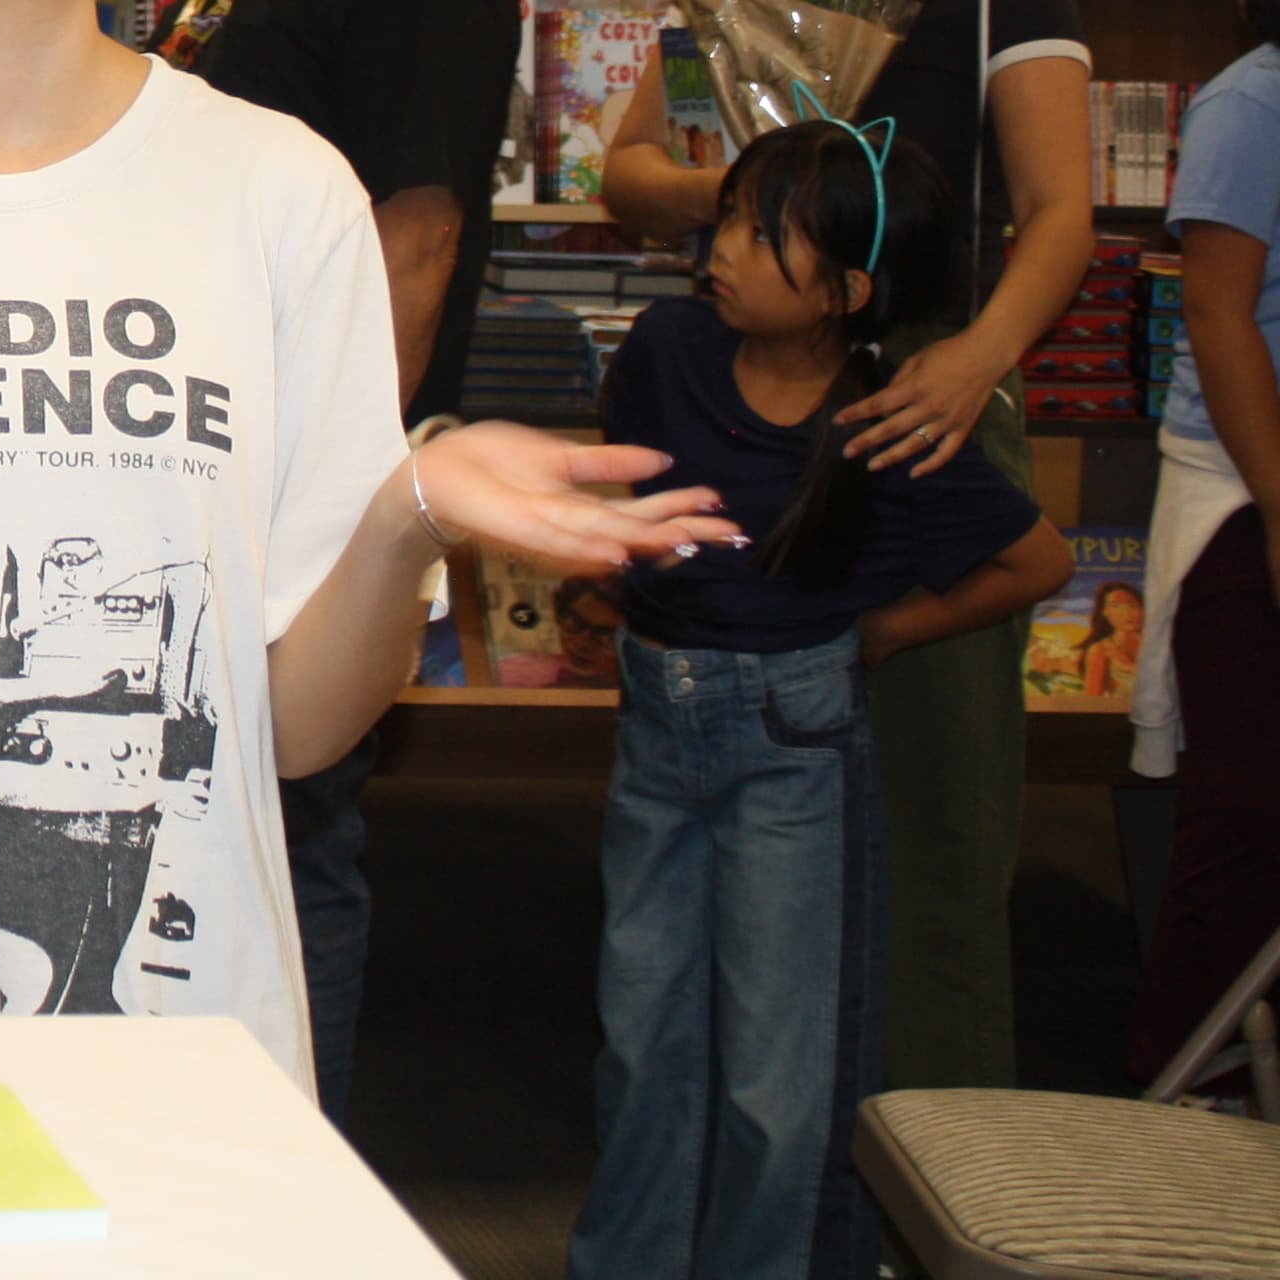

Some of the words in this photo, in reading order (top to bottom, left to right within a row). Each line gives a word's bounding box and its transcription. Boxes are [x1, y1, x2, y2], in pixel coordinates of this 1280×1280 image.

[599, 21, 653, 41] COZY
[109, 451, 155, 471] 1984
[182, 458, 219, 482] NYC
